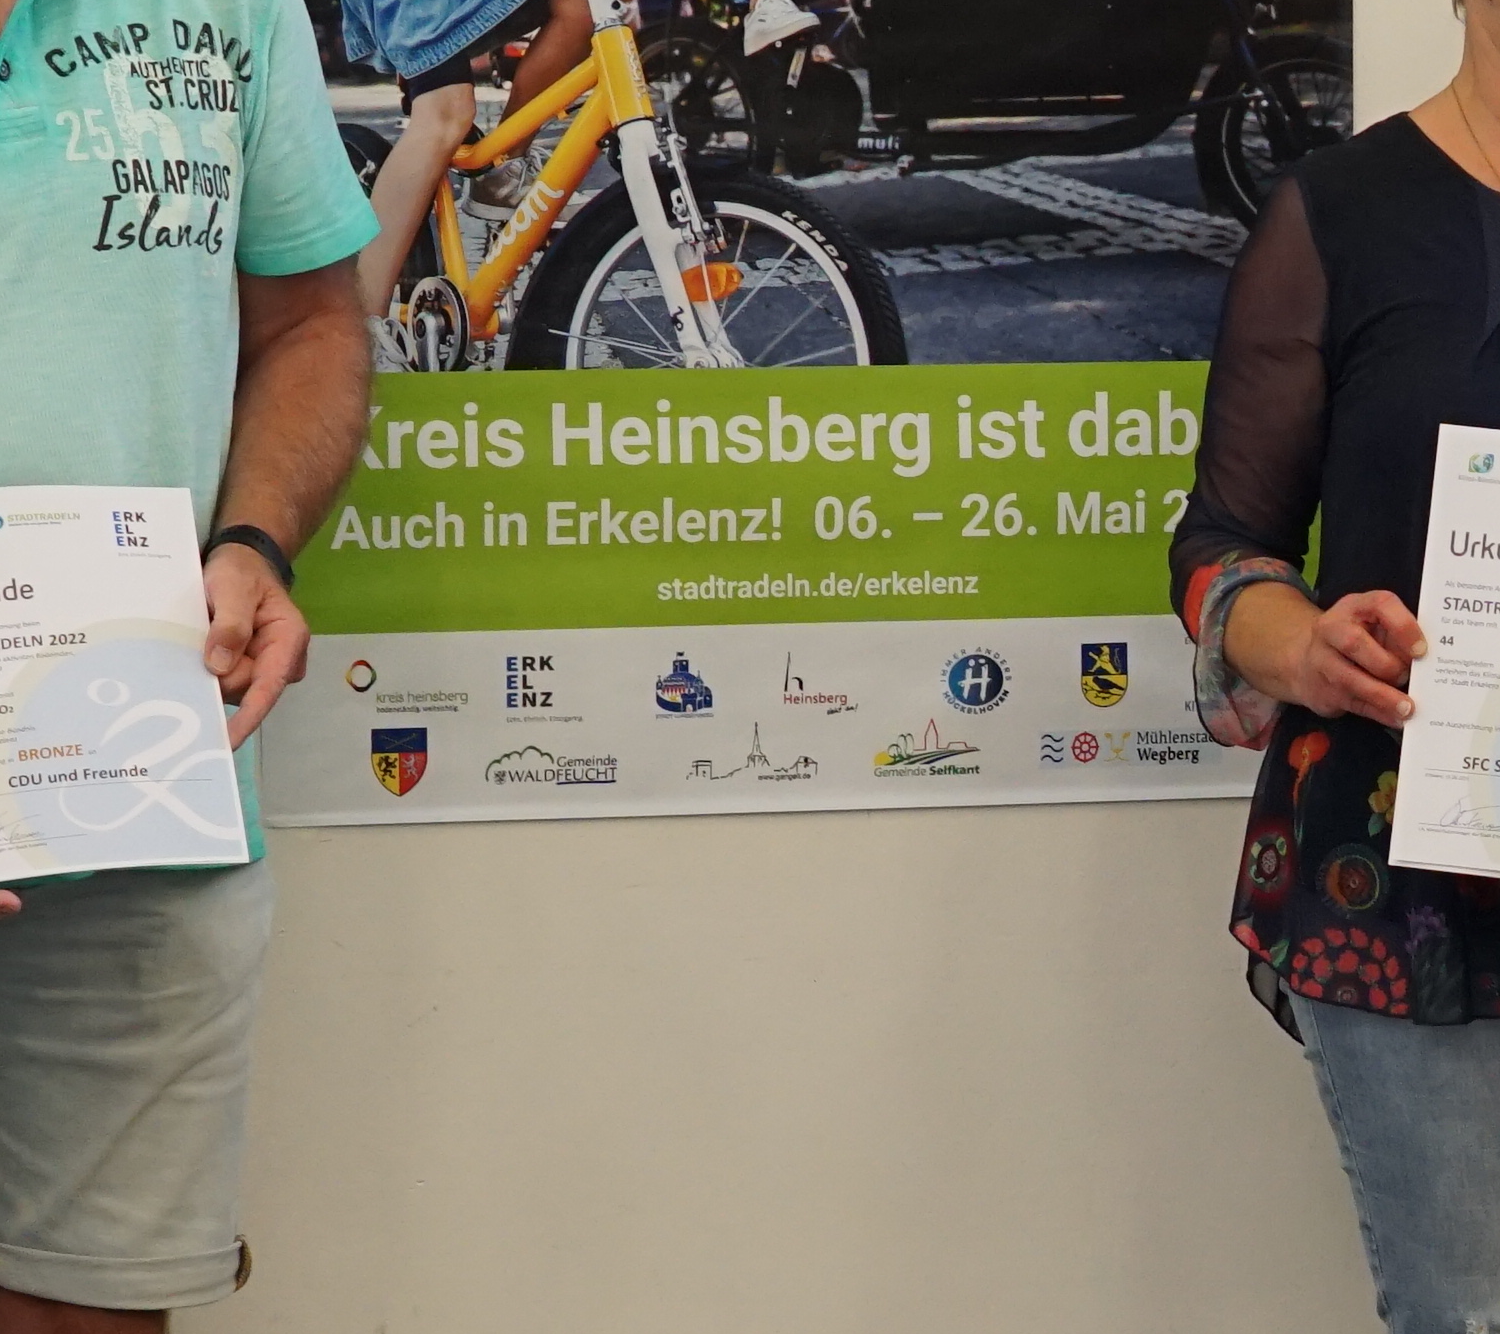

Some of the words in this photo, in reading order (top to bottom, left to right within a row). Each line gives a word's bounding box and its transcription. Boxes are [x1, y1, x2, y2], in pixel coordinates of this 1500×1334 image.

[45, 23, 150, 78] CAMP
[130, 55, 211, 79] AUTHENTIC
[55, 108, 115, 161] 25
[857, 135, 900, 150] muli
[112, 158, 231, 202] GALAPAGOS
[92, 194, 224, 255] Islands
[550, 396, 932, 479] Heinsberg
[958, 395, 1043, 463] ist
[1067, 389, 1200, 459] dab
[6, 512, 81, 523] STADTRADELN
[112, 510, 147, 524] ERK
[330, 501, 465, 550] Auch
[483, 500, 528, 547] in
[546, 498, 783, 547] Erkelenz!
[813, 496, 892, 543] 06.
[960, 492, 1037, 540] 26.
[1055, 488, 1147, 536] Mai
[114, 523, 135, 535] EL
[116, 536, 150, 548] ENZ
[657, 569, 979, 604] stadtradeln.de/erkelenz
[48, 632, 88, 647] 2022
[1439, 635, 1454, 646] 44
[506, 655, 556, 672] ERK
[975, 646, 1013, 681] ANDERS
[506, 673, 535, 690] EL
[376, 691, 404, 704] kreis
[407, 689, 469, 705] heinsberg
[506, 691, 554, 708] ENZ
[783, 691, 848, 706] Heinsberg
[17, 743, 85, 762] BRONZE
[556, 754, 618, 768] Gemeinde
[1136, 747, 1200, 764] Wegberg
[873, 766, 927, 777] Gemeinde
[928, 765, 981, 776] Selfkant
[1462, 755, 1491, 772] SFC
[7, 773, 43, 788] CDU
[47, 768, 78, 784] und
[82, 764, 149, 781] Freunde
[507, 767, 617, 783] WALDFEUCHT
